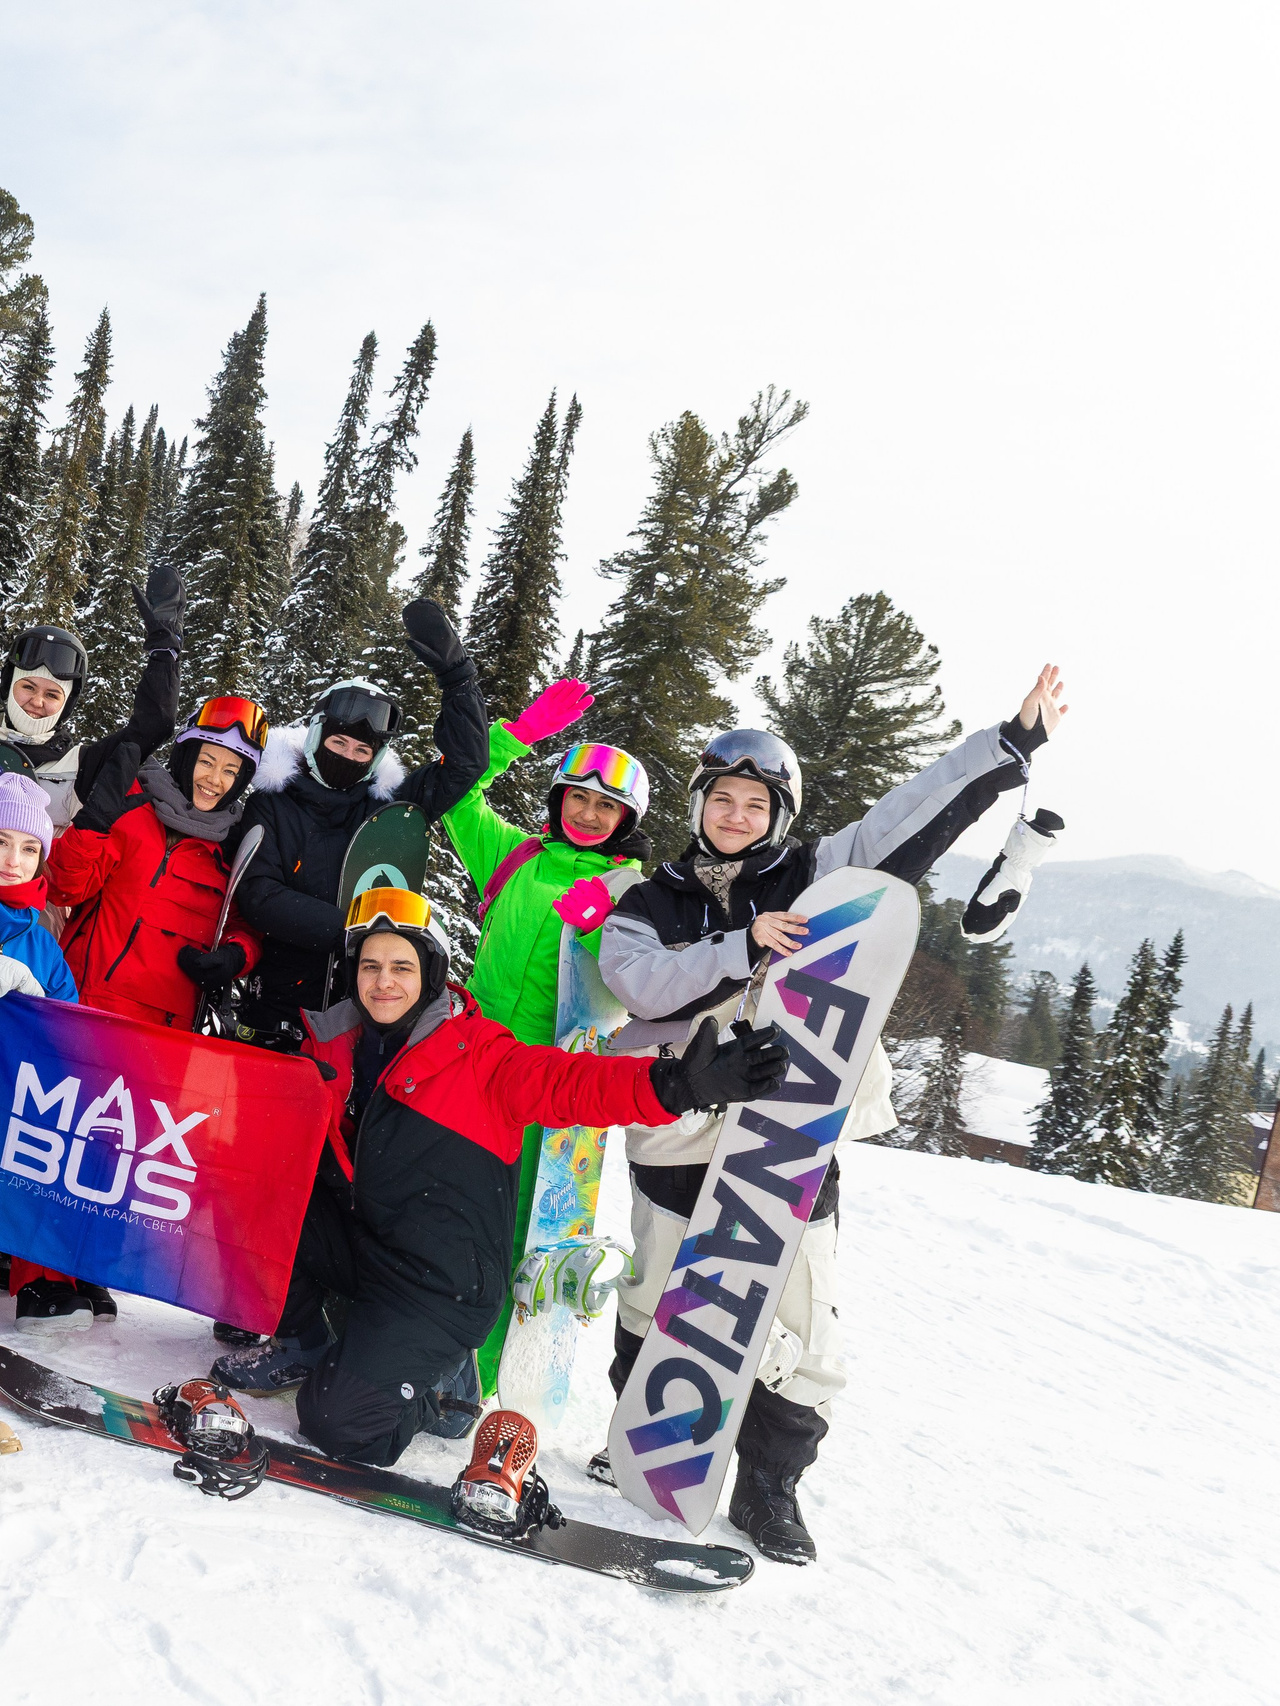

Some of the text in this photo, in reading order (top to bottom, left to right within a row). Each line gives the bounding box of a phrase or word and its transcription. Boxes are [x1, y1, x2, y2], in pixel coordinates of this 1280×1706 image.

[11, 1060, 210, 1168] MAX
[0, 1115, 198, 1221] BUS
[7, 1175, 78, 1210] ДРУЗЬЯМИ
[80, 1201, 99, 1216] НА
[103, 1207, 141, 1225] КРАЙ
[142, 1217, 184, 1236] СВЕТА
[645, 967, 870, 1446] FANATIC
